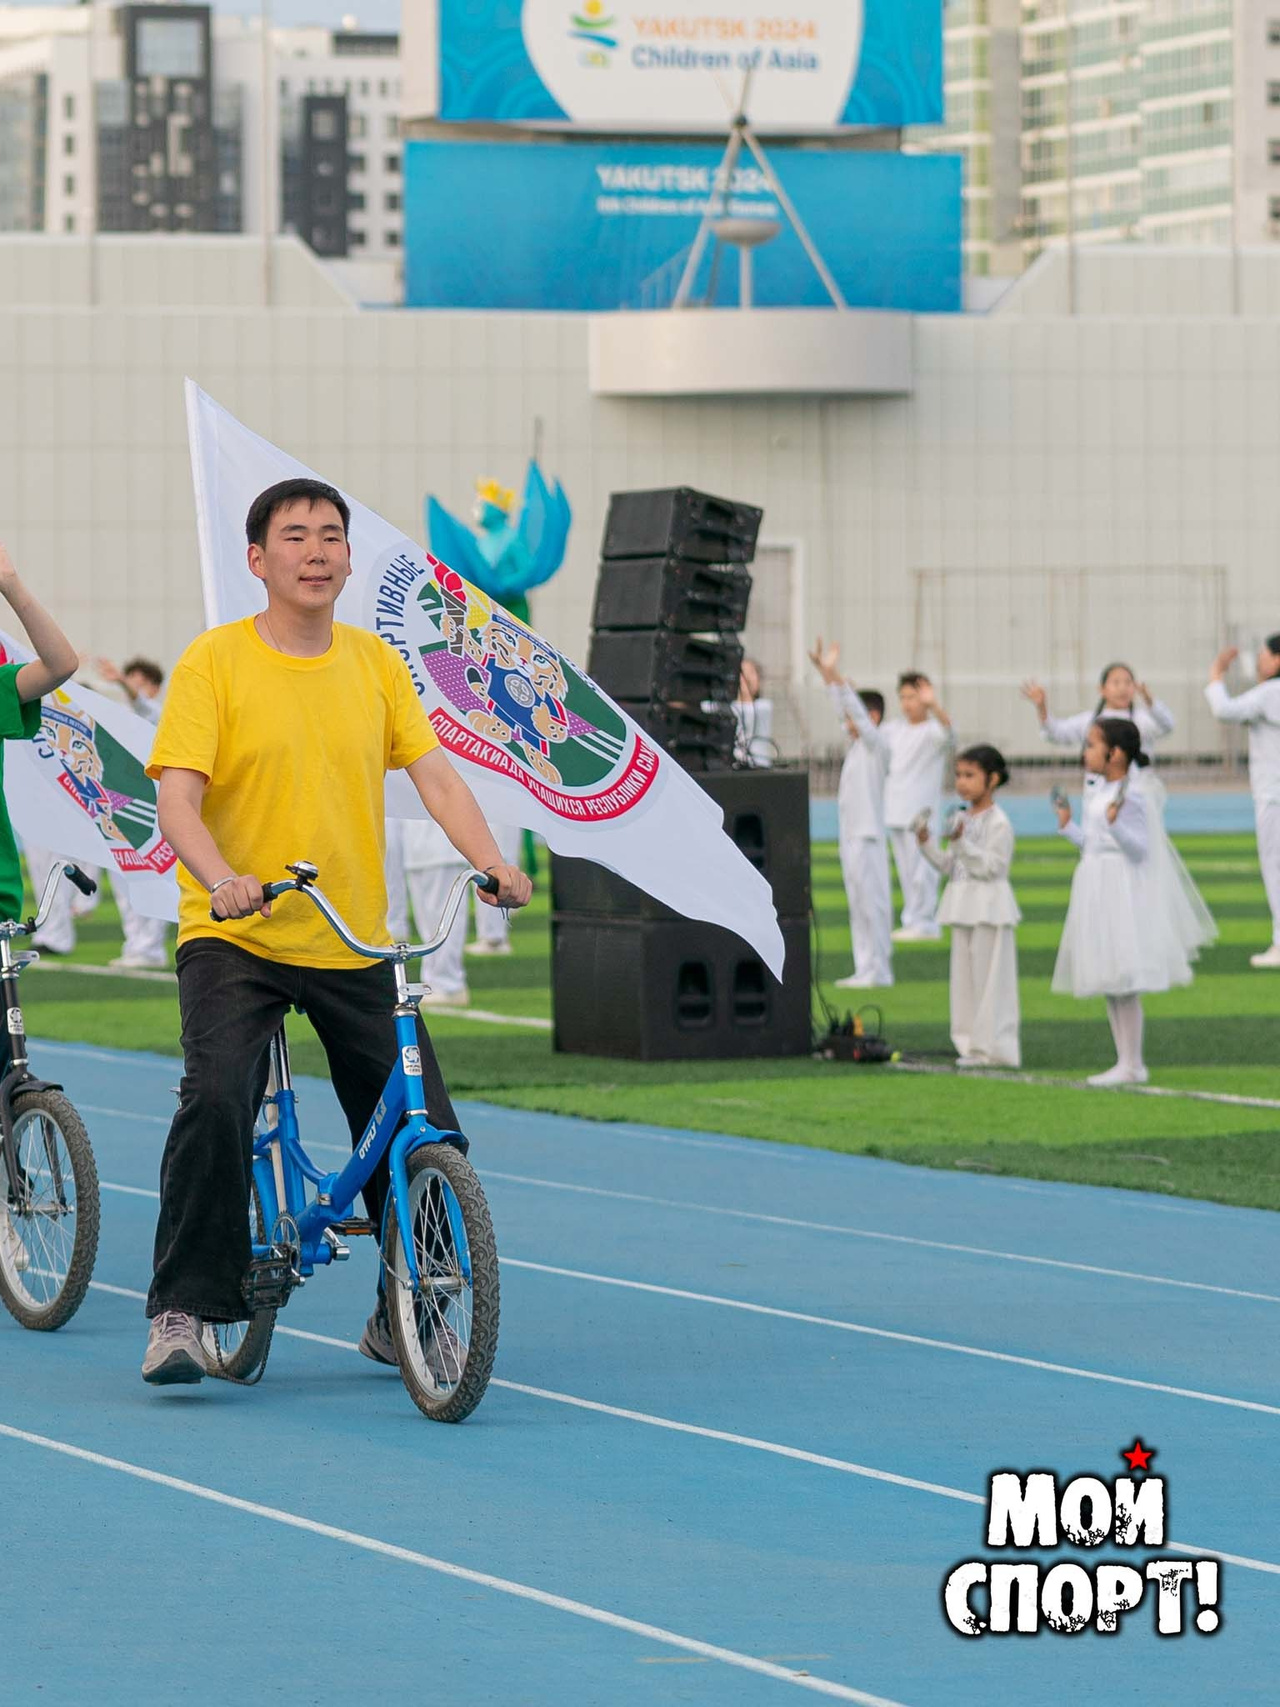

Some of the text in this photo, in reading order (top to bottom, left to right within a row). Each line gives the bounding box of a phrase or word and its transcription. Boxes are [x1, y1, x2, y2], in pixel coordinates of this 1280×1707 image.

[631, 17, 817, 41] YAKUTSK 2024
[632, 45, 819, 72] Children of Asia
[595, 165, 708, 191] YAKUTSK
[376, 554, 426, 696] РТИВНЫЕ
[527, 778, 585, 816] УЧАЩИХСЯ
[587, 769, 646, 816] РЕСПУБЛИКИ
